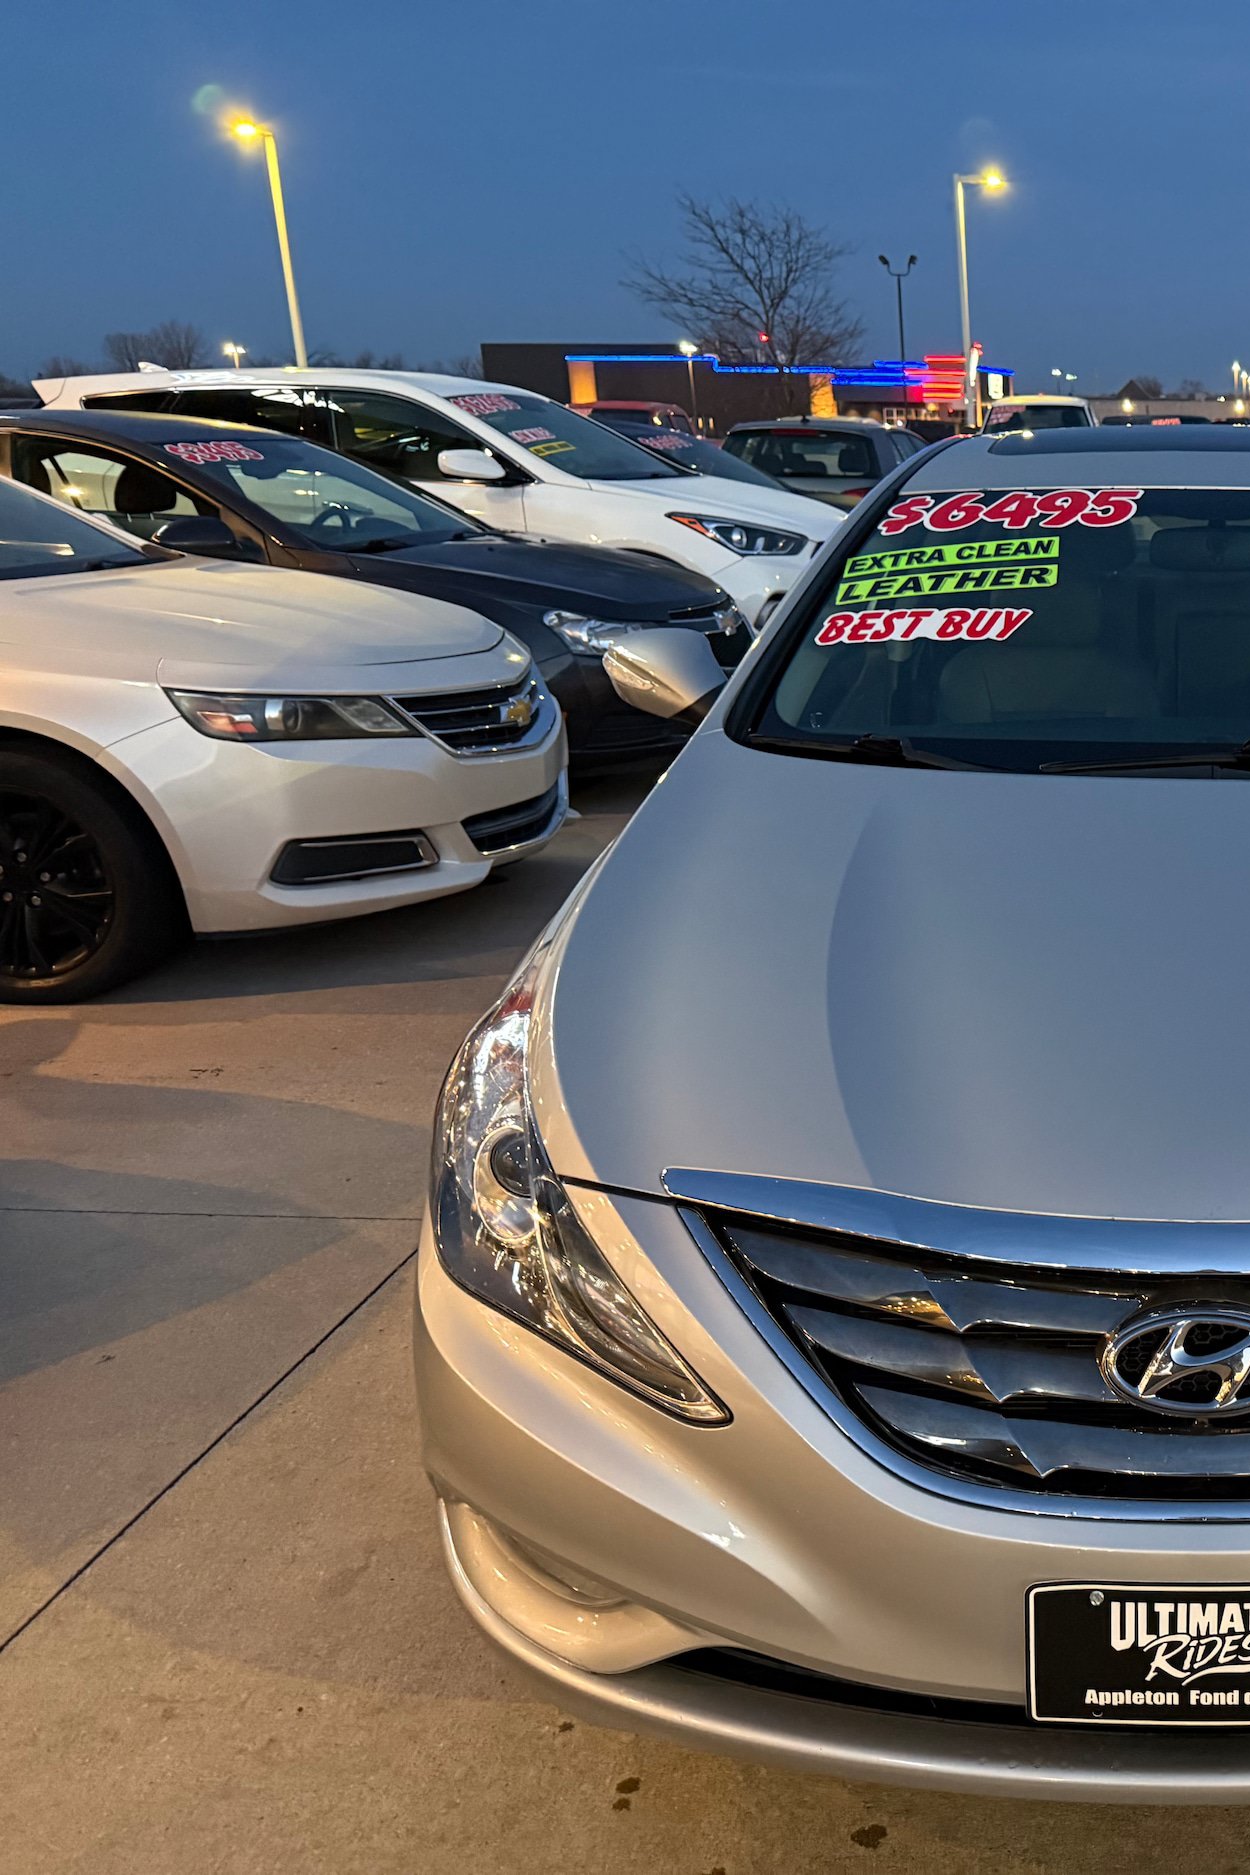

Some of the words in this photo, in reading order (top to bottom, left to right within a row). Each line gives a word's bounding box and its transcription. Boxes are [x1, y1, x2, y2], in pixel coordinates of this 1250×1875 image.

[163, 441, 264, 464] $3495
[878, 489, 1144, 535] $6495
[848, 549, 944, 574] EXTRA
[955, 539, 1053, 561] CLEAN
[838, 567, 1051, 603] LEATHER
[817, 610, 933, 644] BEST
[935, 609, 1031, 641] BUY
[1085, 1689, 1180, 1706] Appleton
[1190, 1689, 1239, 1706] Fond
